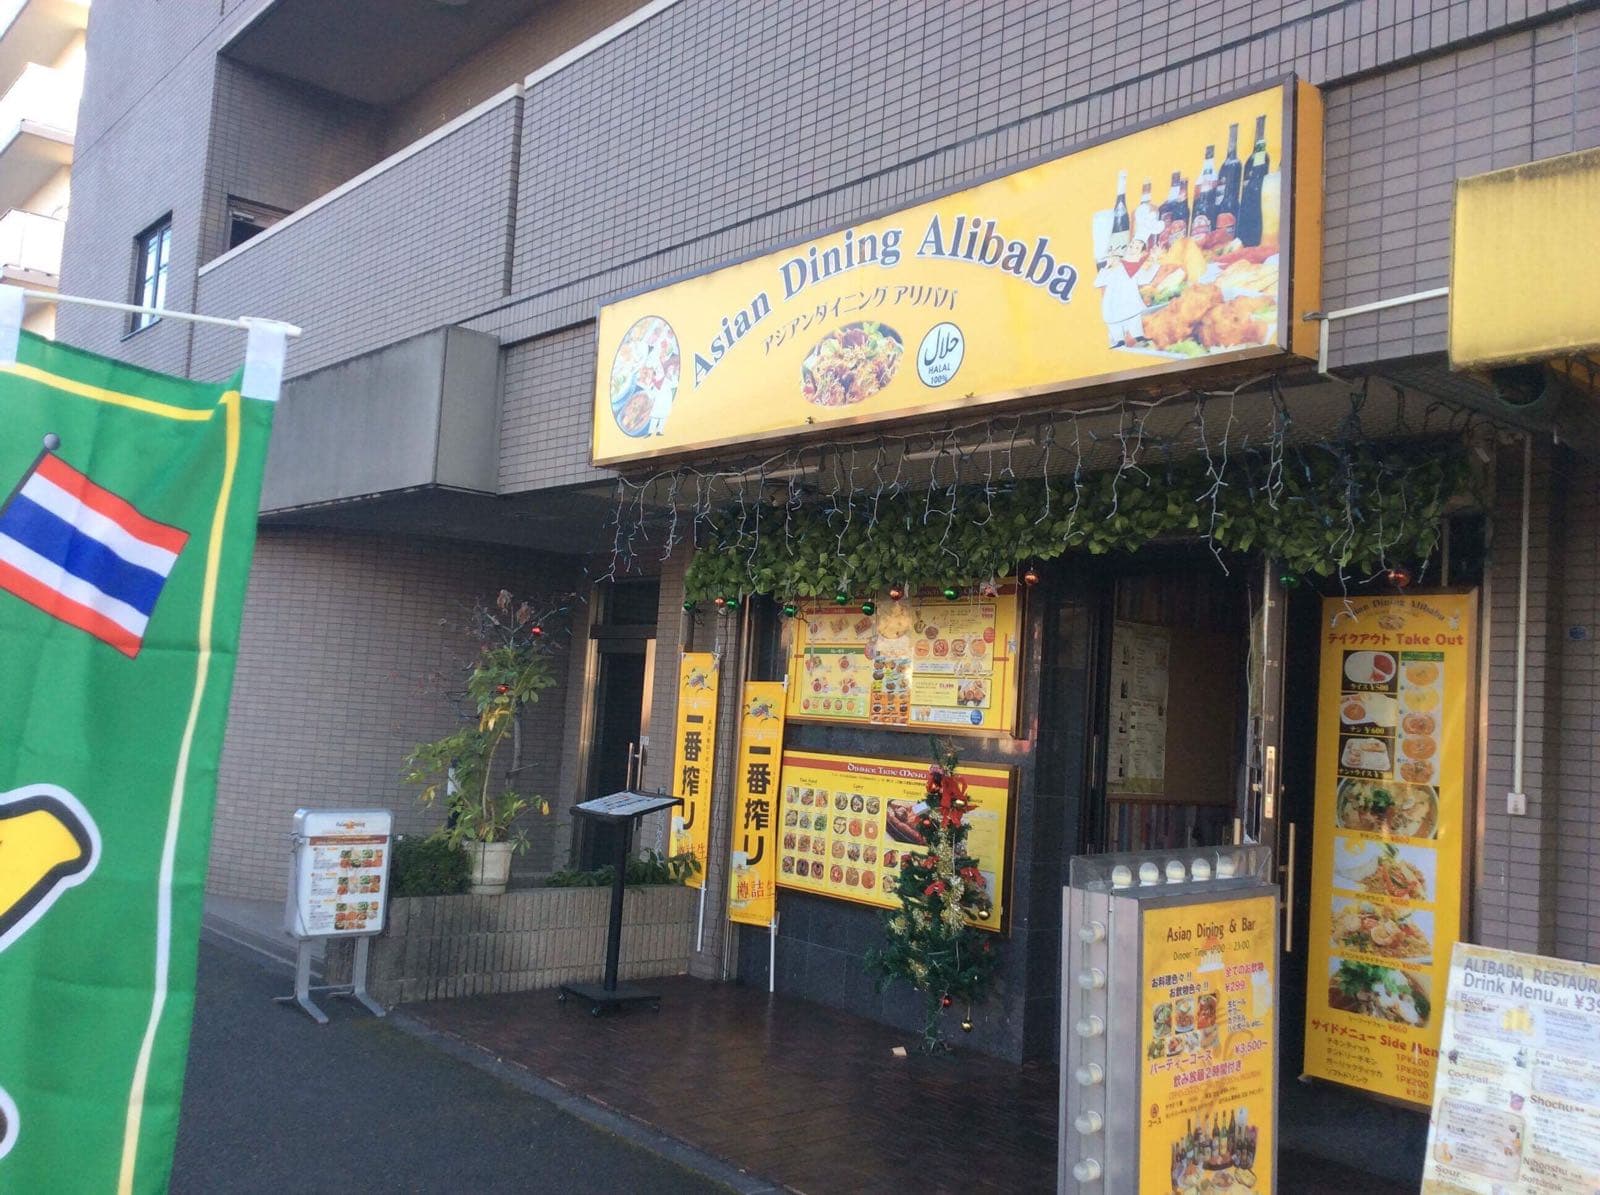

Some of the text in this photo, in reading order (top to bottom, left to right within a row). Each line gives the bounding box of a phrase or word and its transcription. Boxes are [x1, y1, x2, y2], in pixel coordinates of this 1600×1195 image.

[691, 213, 1080, 389] Asian Dining Alibaba
[762, 286, 888, 356] アジアンダイニング
[924, 327, 959, 367] حلال
[927, 363, 951, 375] HALAL
[930, 375, 948, 385] 100%
[1328, 633, 1465, 645] テイクアウト Take Out
[681, 713, 705, 831] 一番搾り
[743, 744, 772, 866] 一番搾り
[1167, 917, 1257, 943] Asian Dining & Bar
[1173, 951, 1192, 961] Dinner
[1464, 957, 1600, 996] ALIBABA RESTAUR
[1464, 972, 1506, 994] Drink
[1510, 980, 1554, 1003] Menu
[1460, 992, 1485, 1007] Beer
[1311, 1018, 1440, 1058] サイドメニュー Side Men
[1150, 1049, 1212, 1075] パーティーコース
[1447, 1069, 1489, 1084] Cocktail
[1529, 1094, 1573, 1113] Shochu
[1523, 1157, 1568, 1177] Nihonshu
